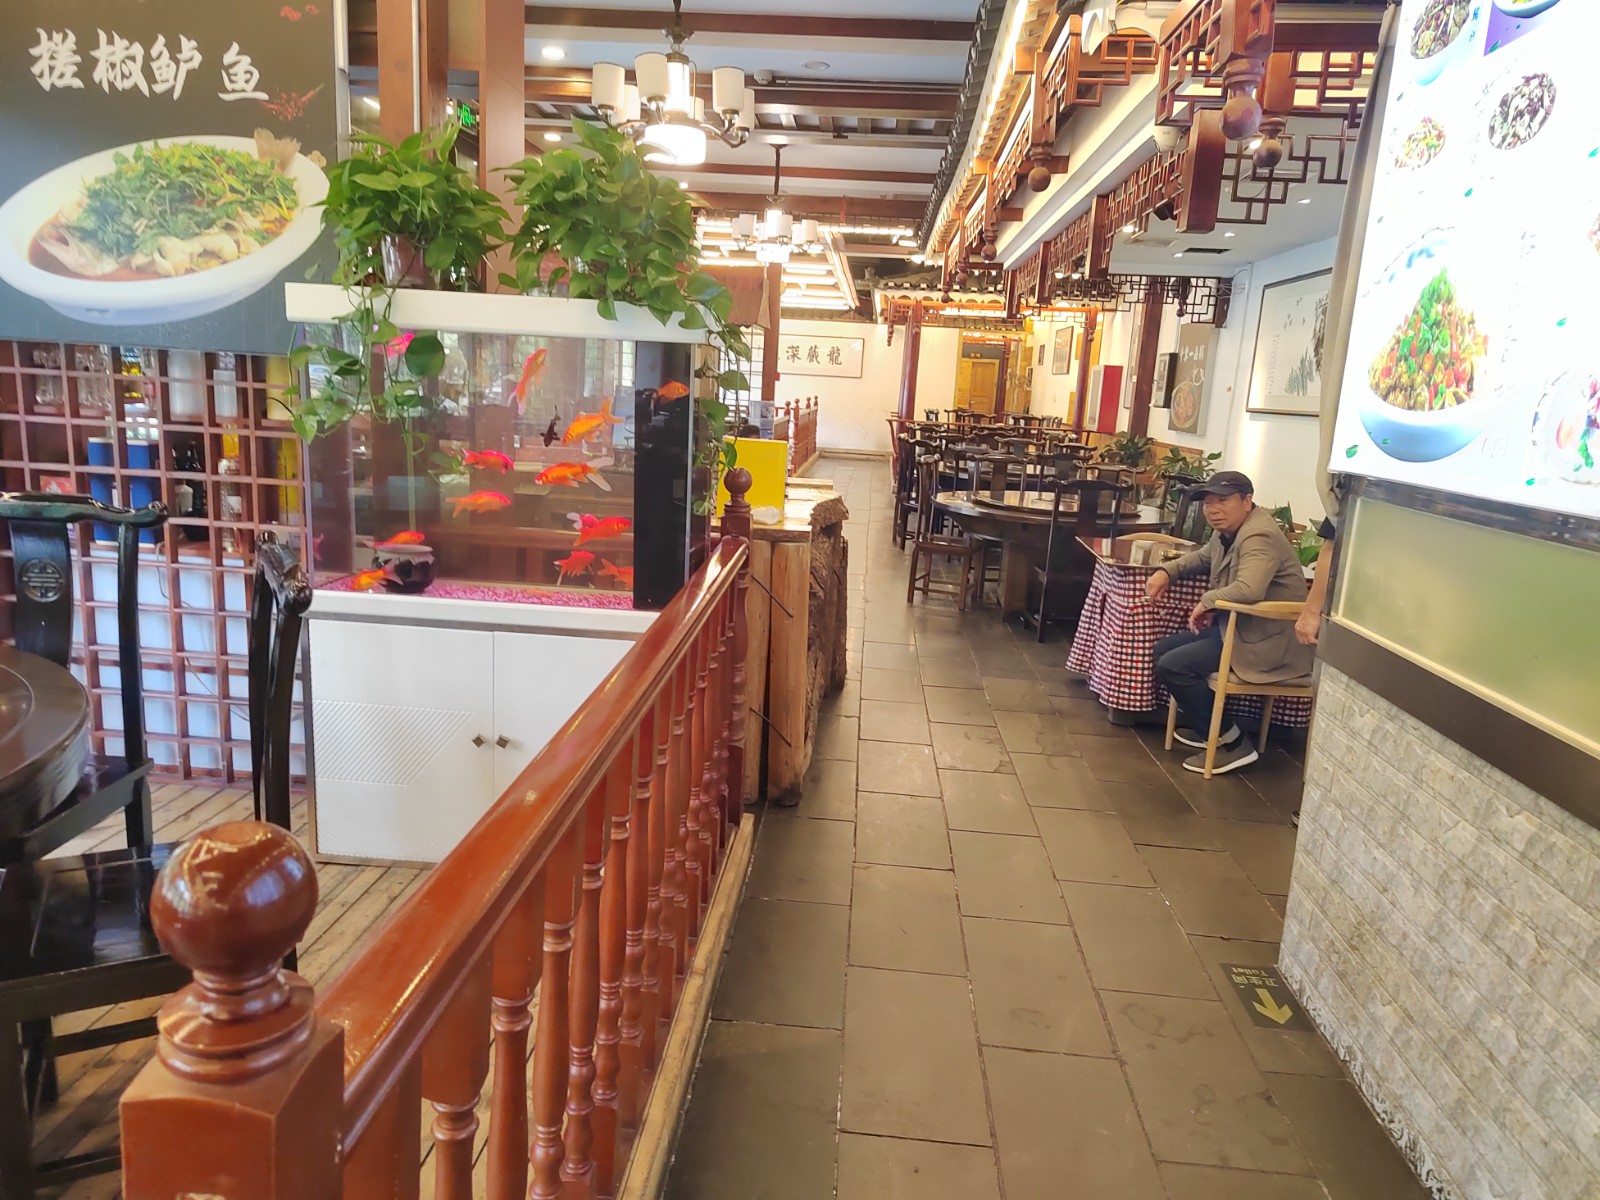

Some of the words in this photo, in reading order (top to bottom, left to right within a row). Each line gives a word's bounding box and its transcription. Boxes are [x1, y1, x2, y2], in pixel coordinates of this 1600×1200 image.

[28, 27, 270, 101] 搓椒鲈鱼
[1231, 974, 1279, 988] 卫生间
